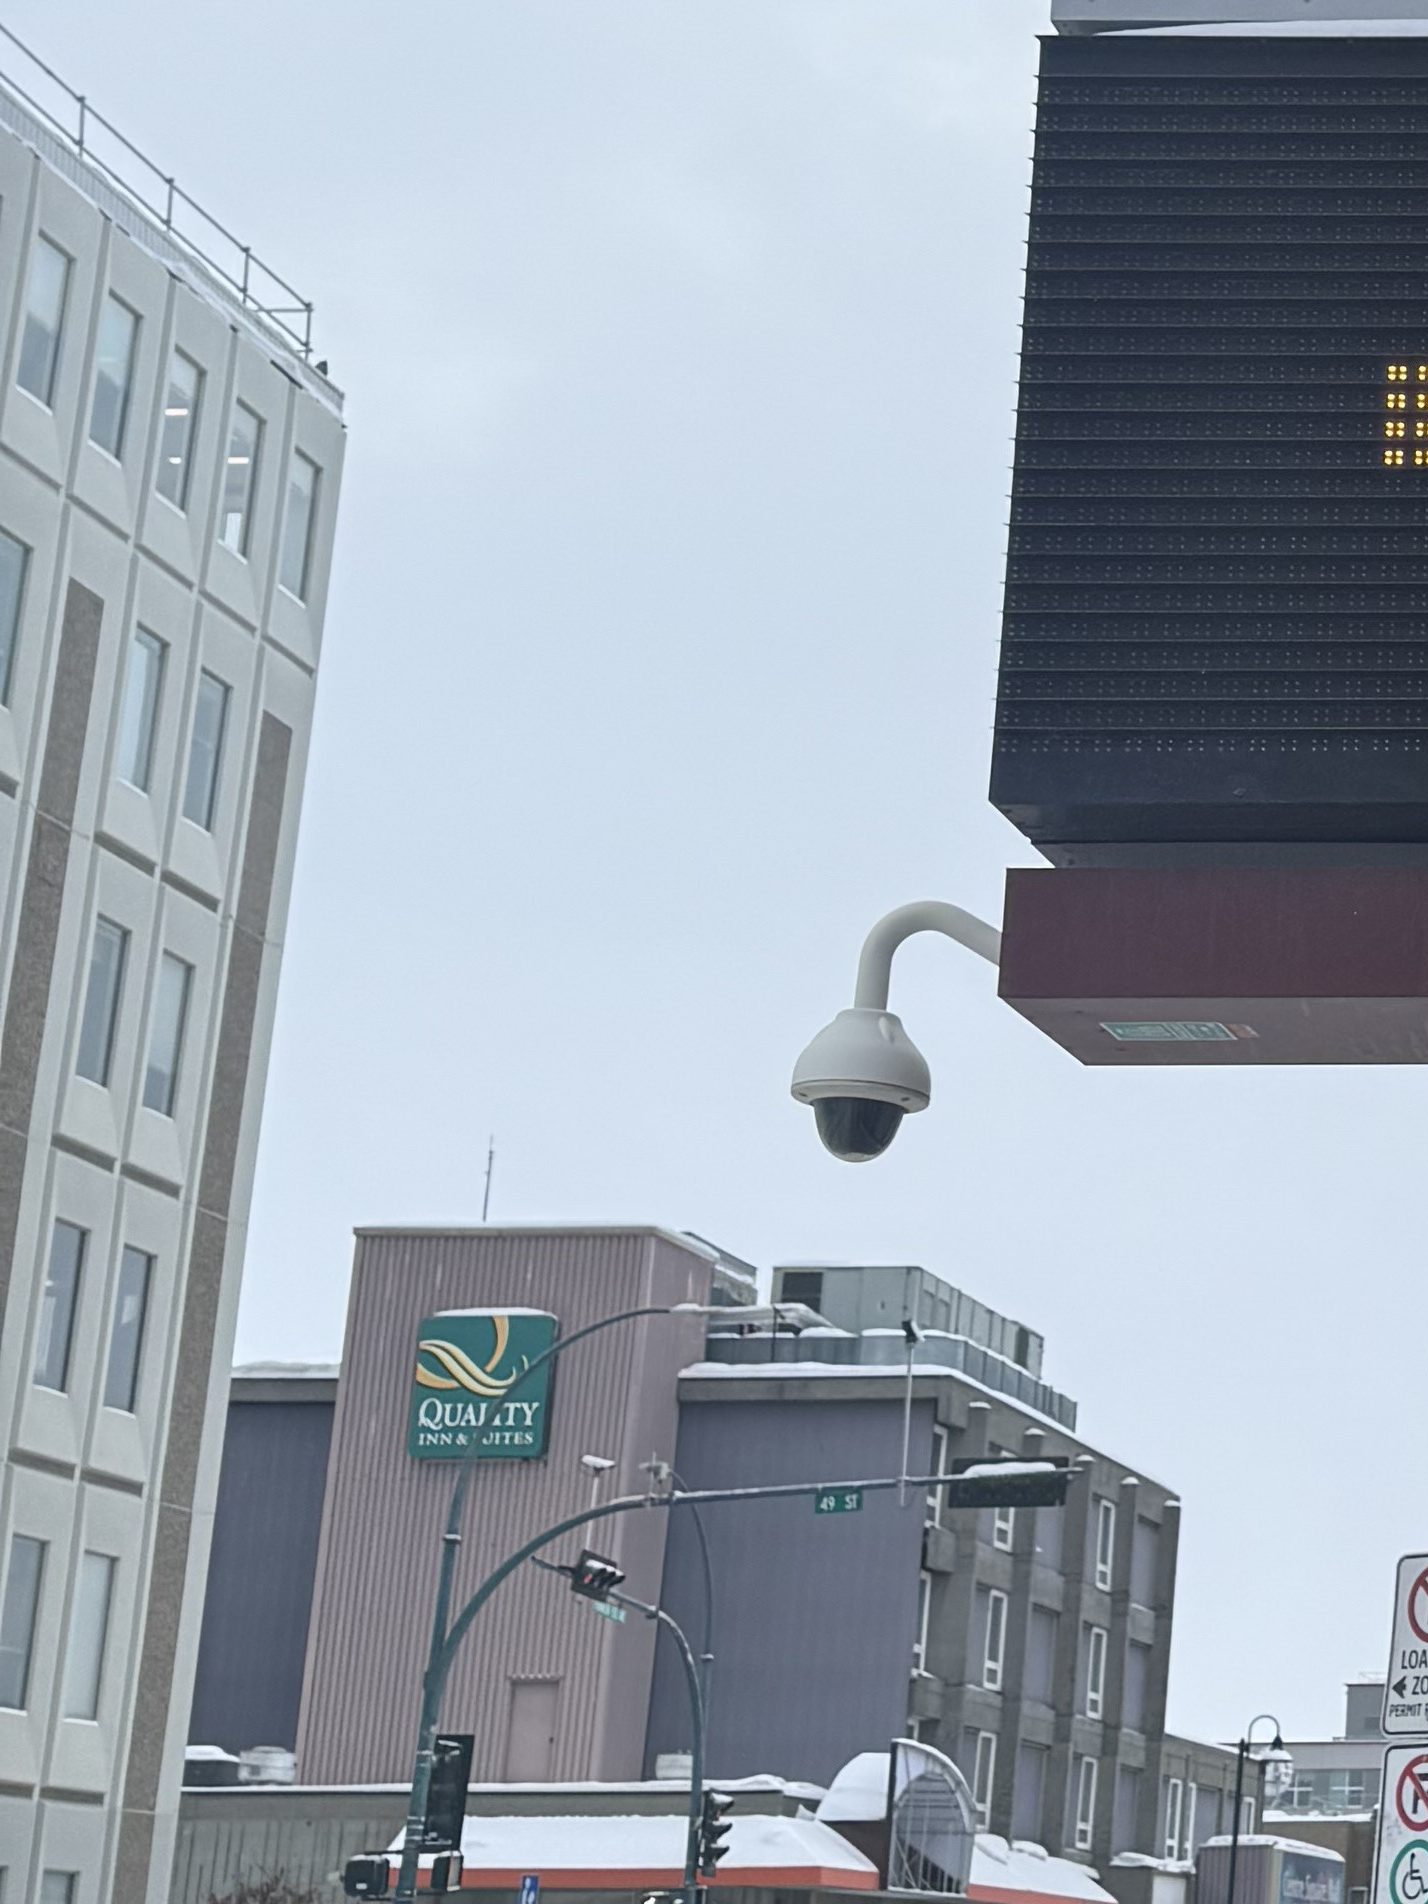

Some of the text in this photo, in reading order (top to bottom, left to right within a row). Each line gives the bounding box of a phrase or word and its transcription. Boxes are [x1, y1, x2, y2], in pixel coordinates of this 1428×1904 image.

[418, 1432, 534, 1446] INN & UITES
[1388, 1703, 1422, 1718] PERMIT
